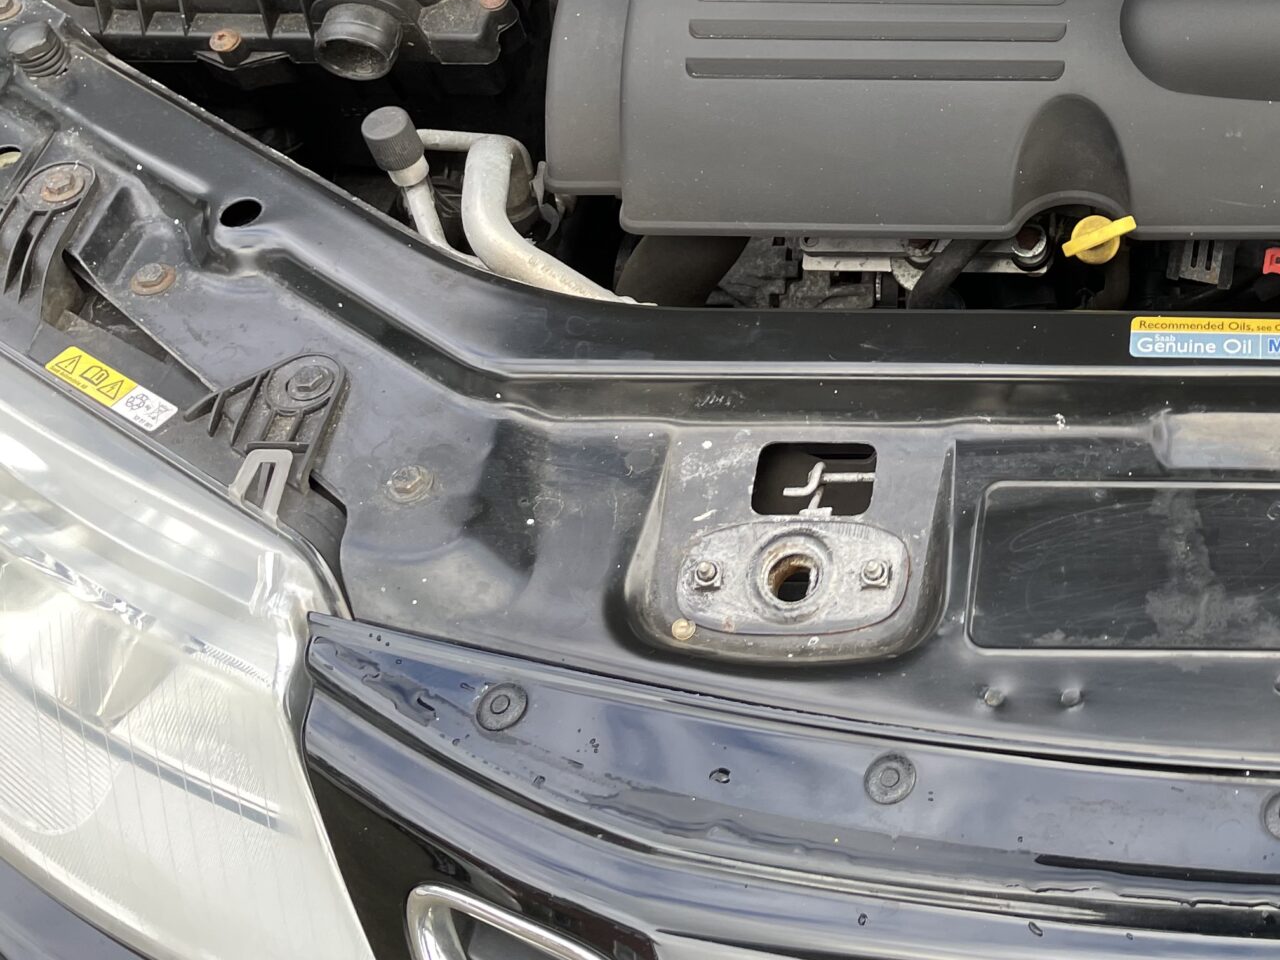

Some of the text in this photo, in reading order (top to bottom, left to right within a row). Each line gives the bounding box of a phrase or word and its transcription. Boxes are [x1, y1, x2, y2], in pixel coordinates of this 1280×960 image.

[1140, 320, 1224, 330] Recommended
[1228, 322, 1254, 332] Oils,
[1137, 337, 1216, 353] Genuine
[1224, 339, 1252, 354] Oil
